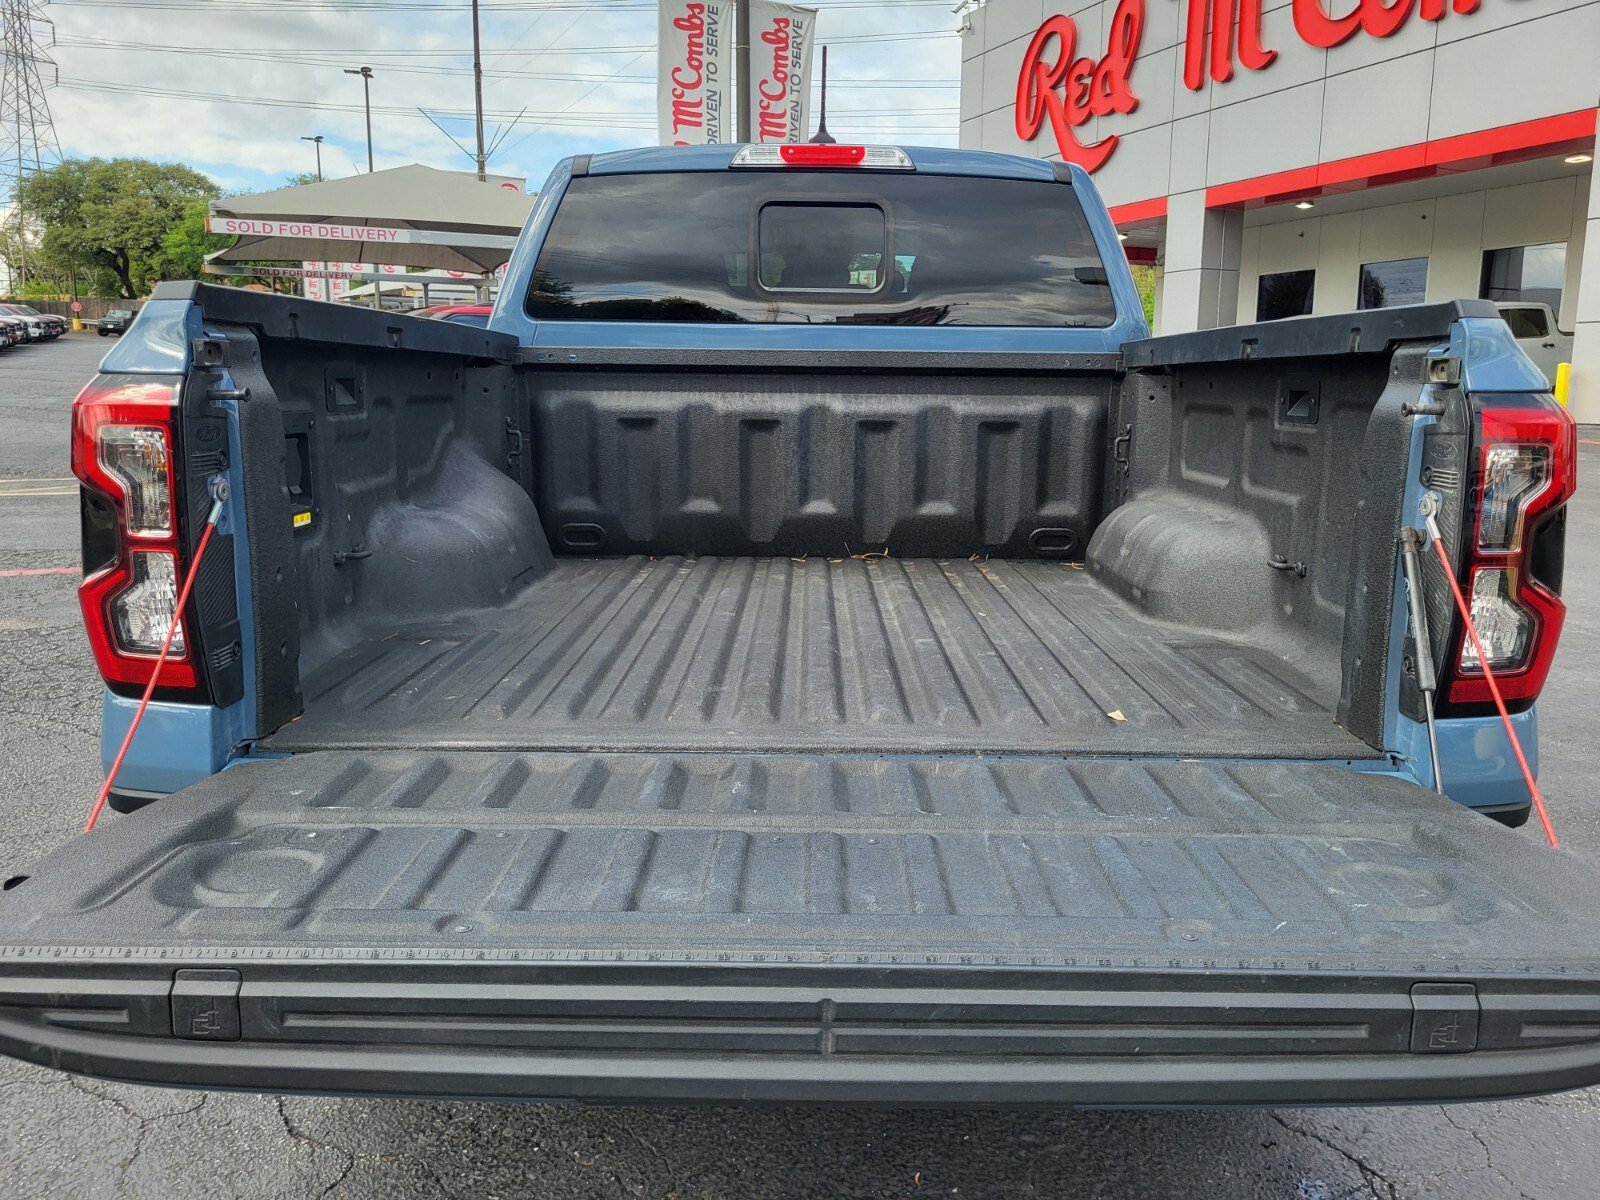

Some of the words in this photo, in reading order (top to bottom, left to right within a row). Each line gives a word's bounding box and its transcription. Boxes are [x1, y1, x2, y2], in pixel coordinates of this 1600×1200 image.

[706, 5, 719, 57] SERVE
[791, 18, 803, 69] SERVE
[672, 3, 705, 135] McCombs
[706, 62, 718, 83] TO
[759, 18, 791, 143] McCombs
[790, 74, 801, 95] TO
[1015, 0, 1145, 174] Red
[788, 100, 800, 144] RIVEN
[226, 220, 273, 234] SOLD
[279, 224, 313, 237] FOR
[318, 226, 398, 241] DELIVERY
[252, 267, 280, 276] SOLD
[283, 269, 303, 277] FOR
[306, 270, 354, 279] DELIVERY
